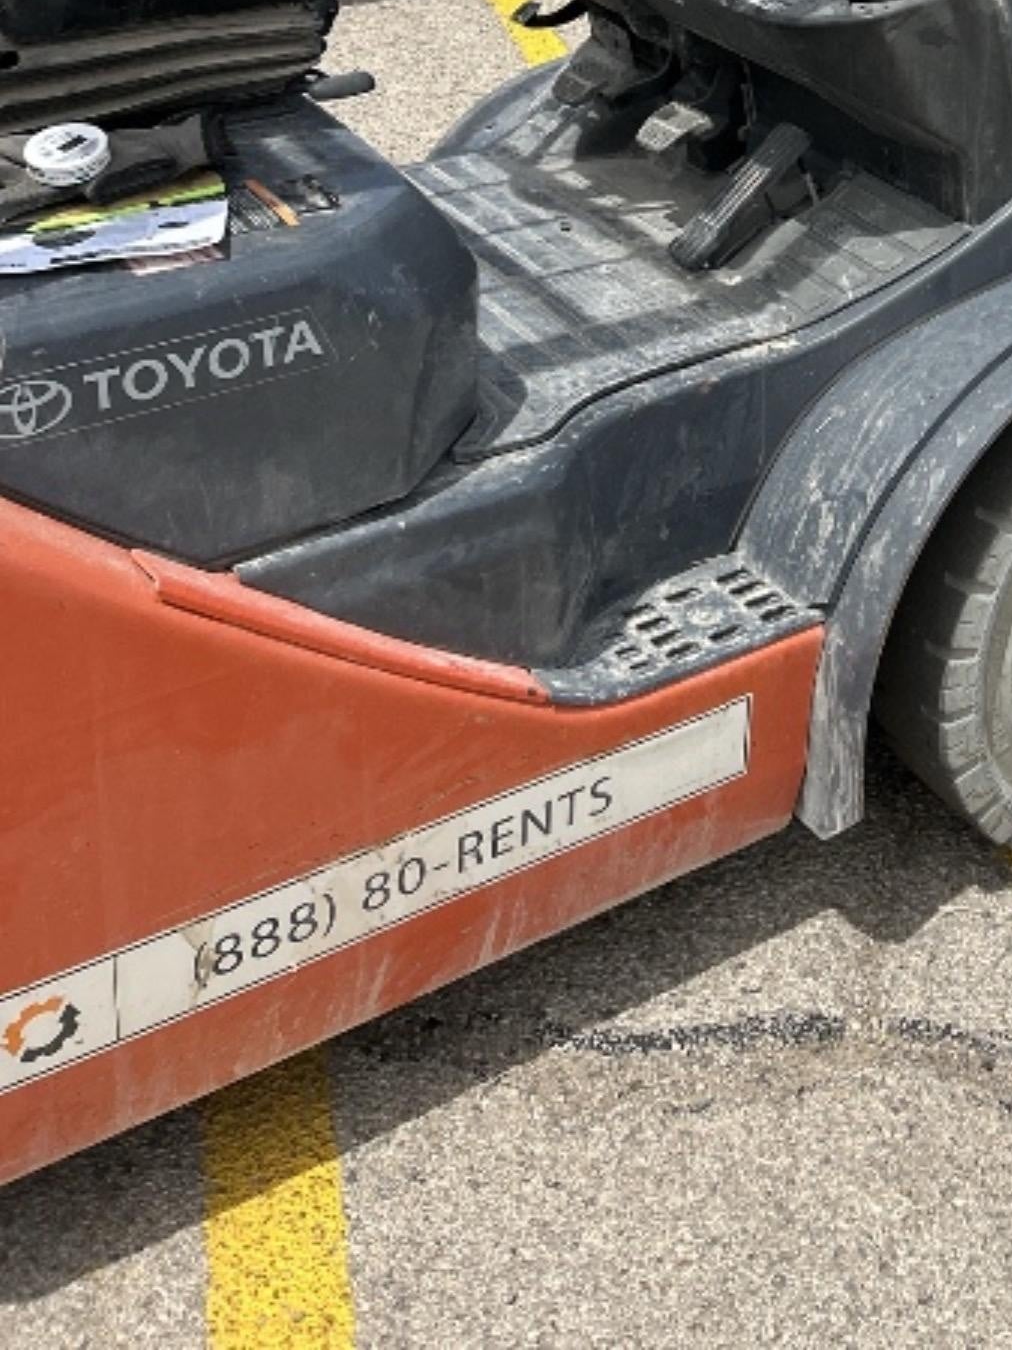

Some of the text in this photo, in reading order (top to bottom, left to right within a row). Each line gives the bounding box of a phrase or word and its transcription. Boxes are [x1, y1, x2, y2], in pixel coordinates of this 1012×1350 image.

[83, 320, 324, 410] TOYOTA
[193, 776, 614, 990] (888) 80-RENTS
